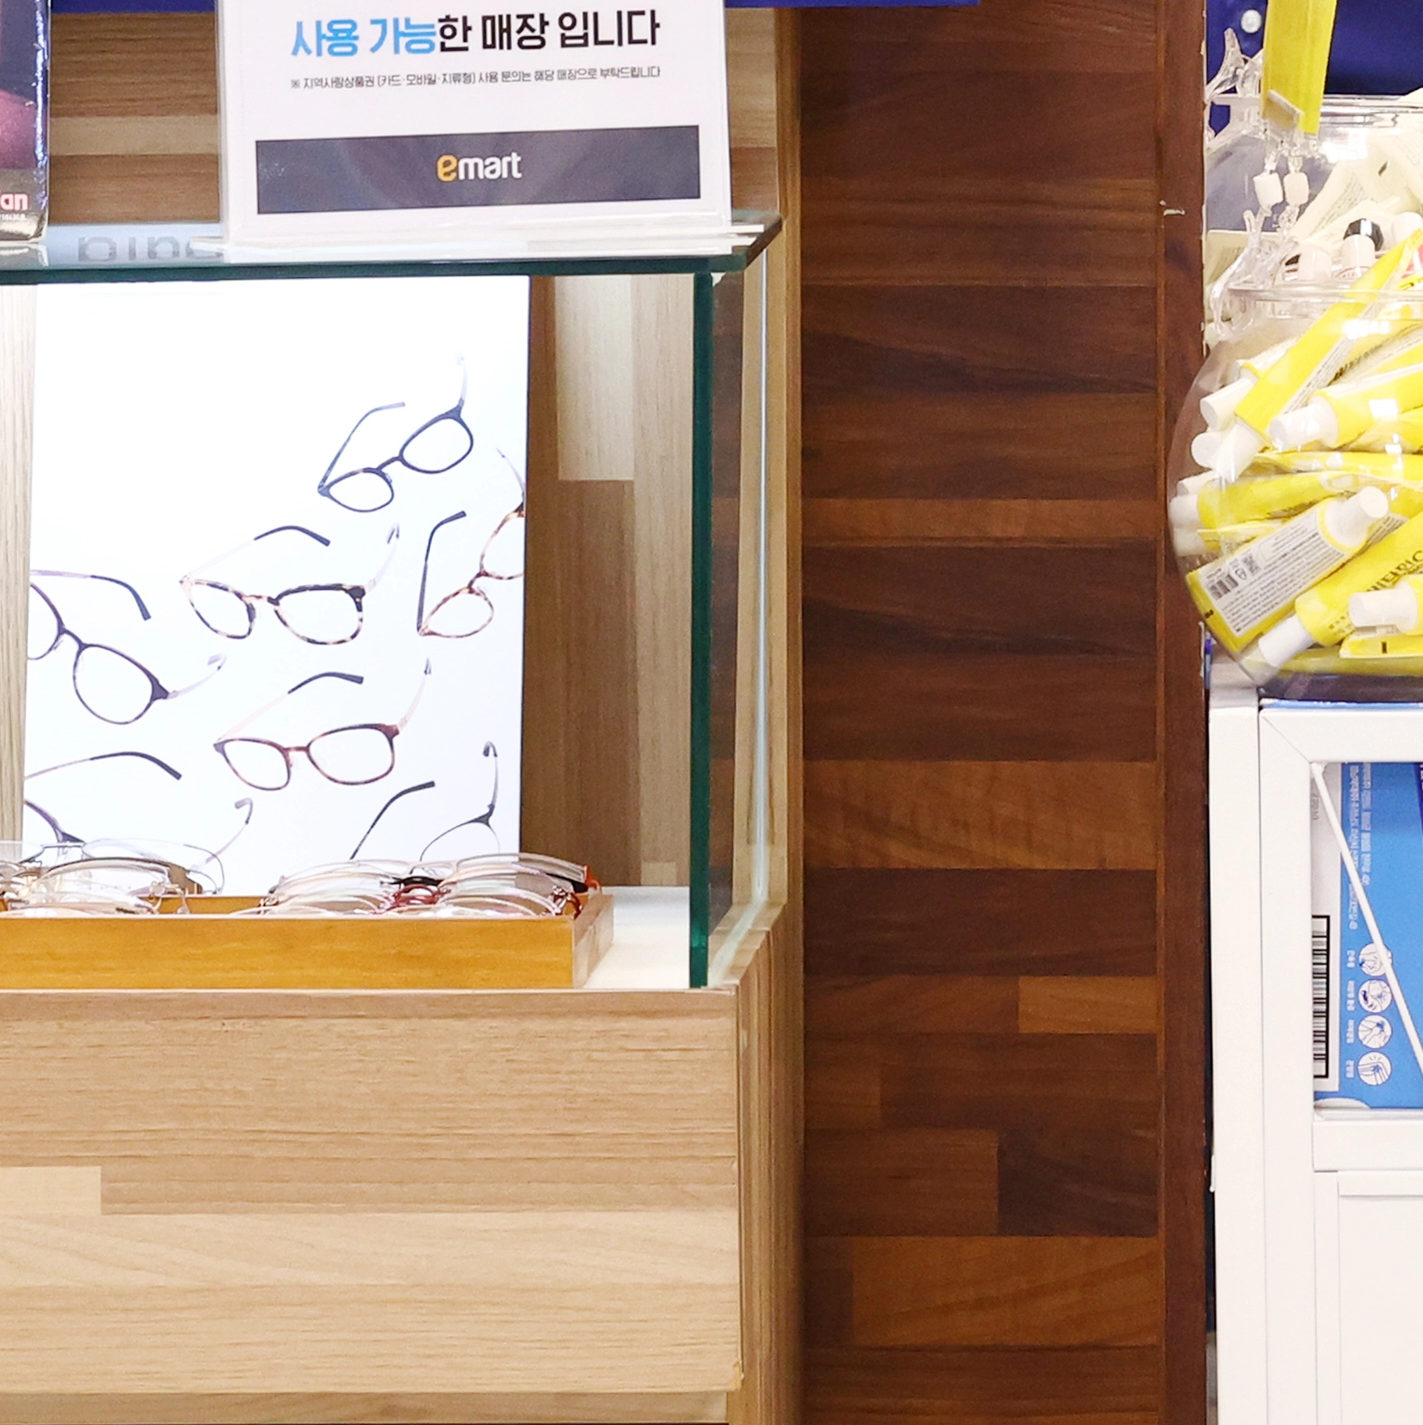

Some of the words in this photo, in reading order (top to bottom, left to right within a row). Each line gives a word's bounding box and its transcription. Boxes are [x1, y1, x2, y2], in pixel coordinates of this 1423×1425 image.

[291, 18, 359, 57] 사용
[369, 14, 473, 55] 가능한
[481, 12, 549, 51] 매장
[557, 9, 661, 49] 입니다
[478, 71, 499, 83] 사용
[501, 70, 532, 83] 문의는
[599, 66, 661, 80] 부탁드립니다
[436, 152, 522, 182] emart
